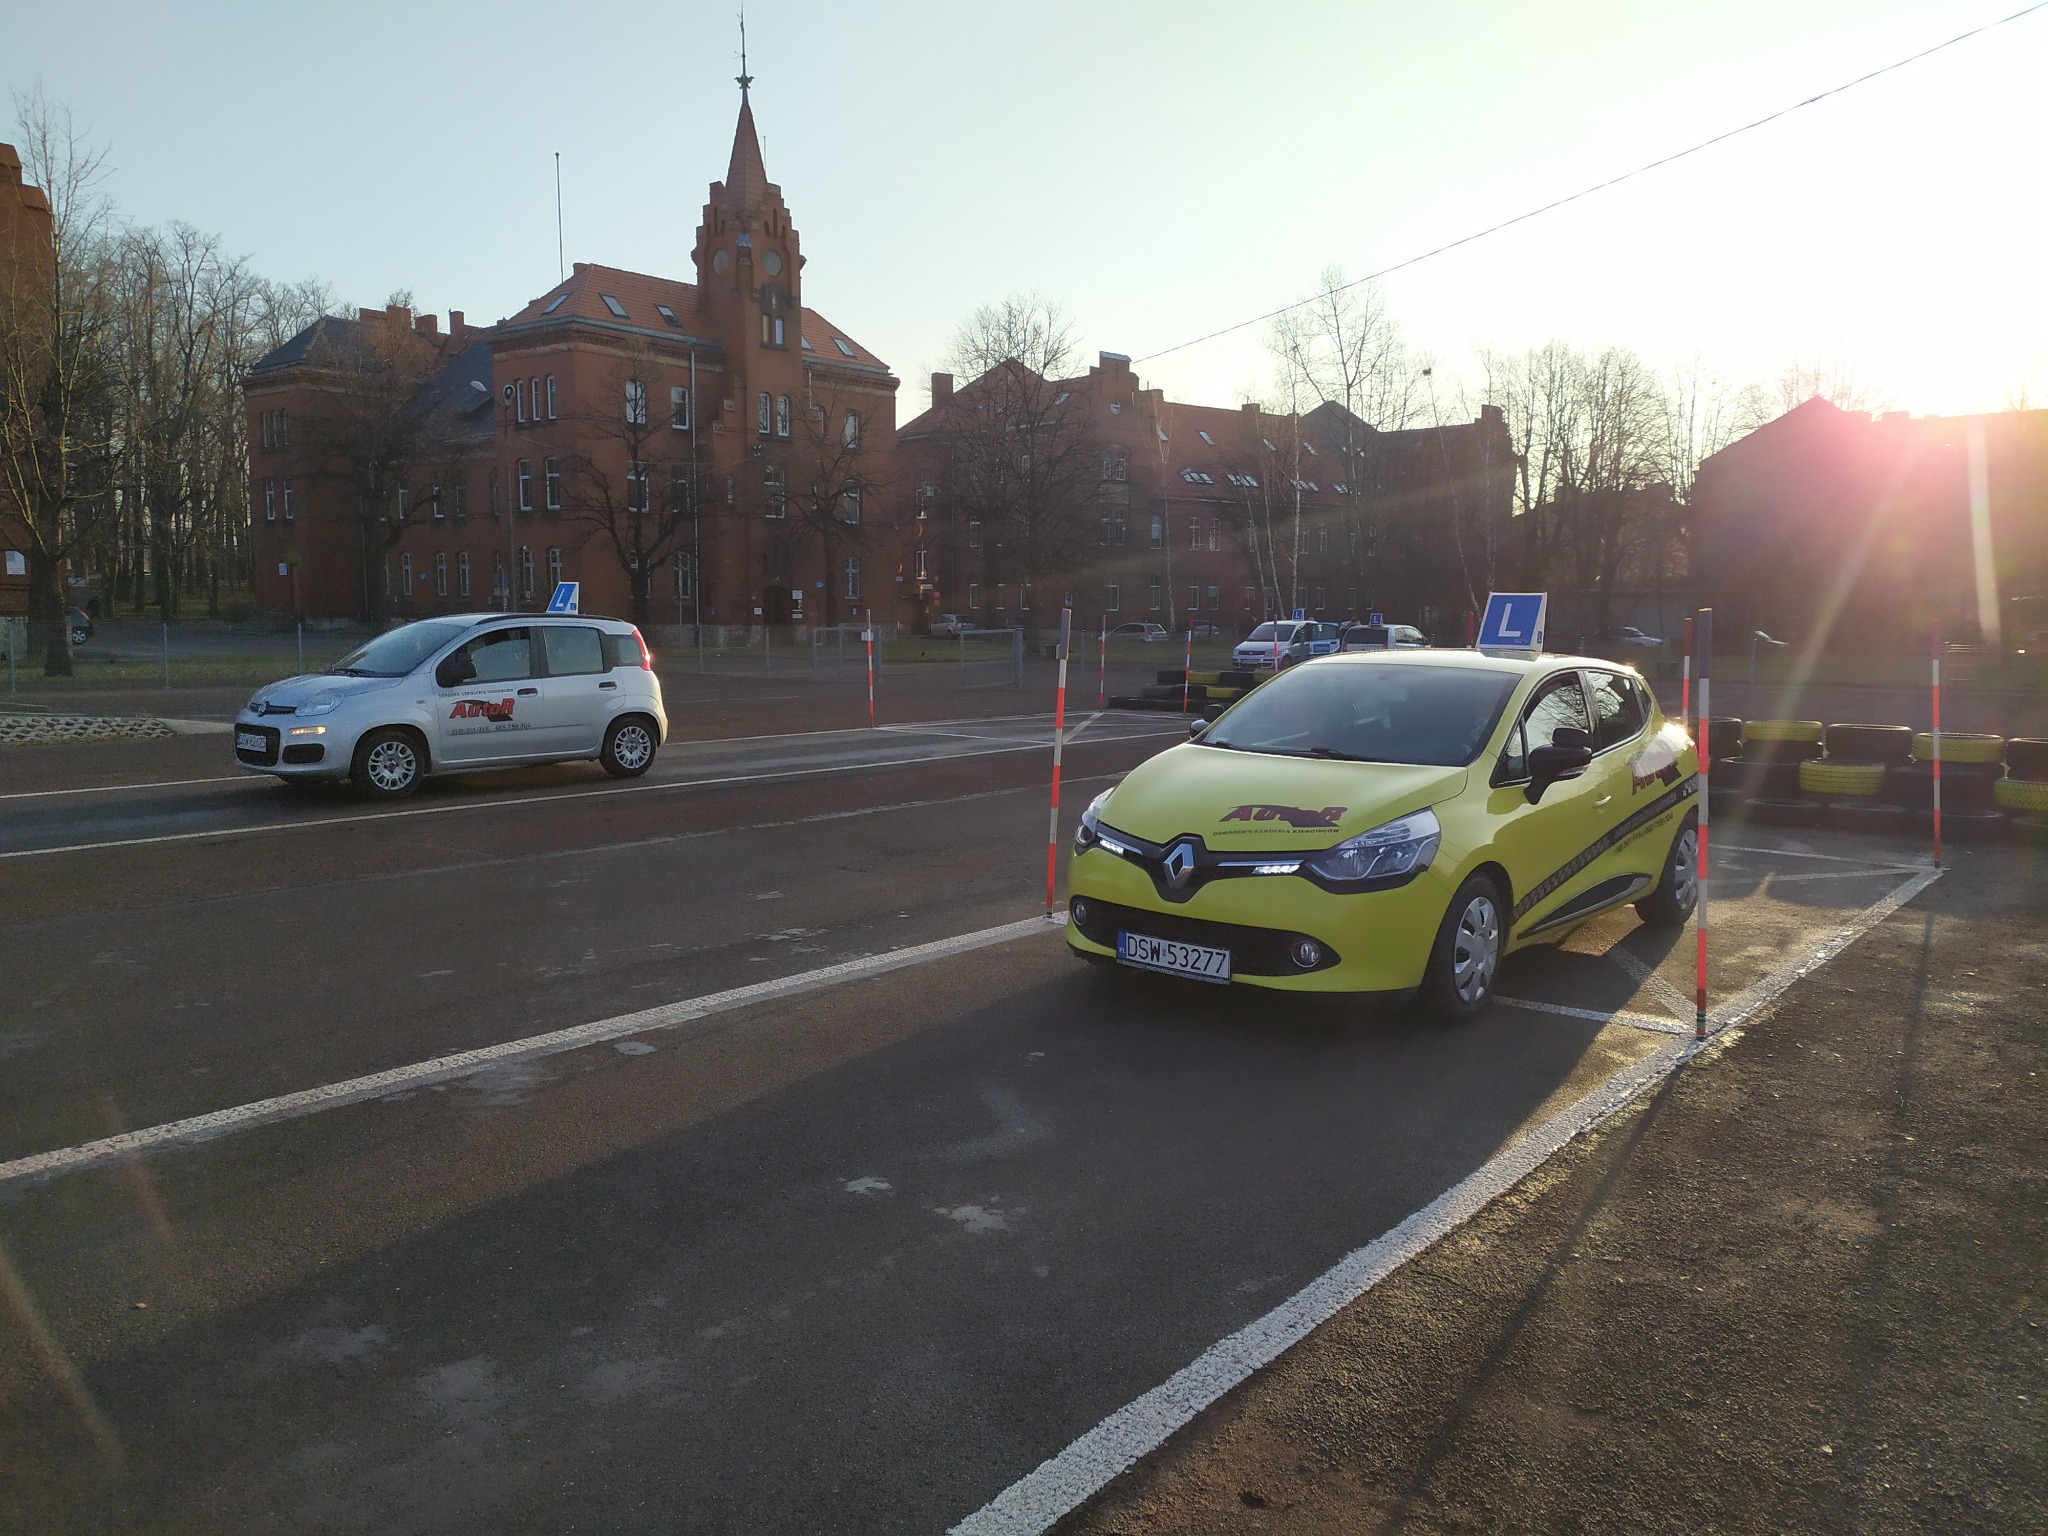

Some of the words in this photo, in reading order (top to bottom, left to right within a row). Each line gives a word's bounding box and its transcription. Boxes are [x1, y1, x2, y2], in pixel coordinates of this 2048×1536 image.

[555, 588, 565, 607] L
[1498, 603, 1522, 637] L
[1127, 935, 1160, 962] DSW
[1167, 943, 1227, 974] 53277
